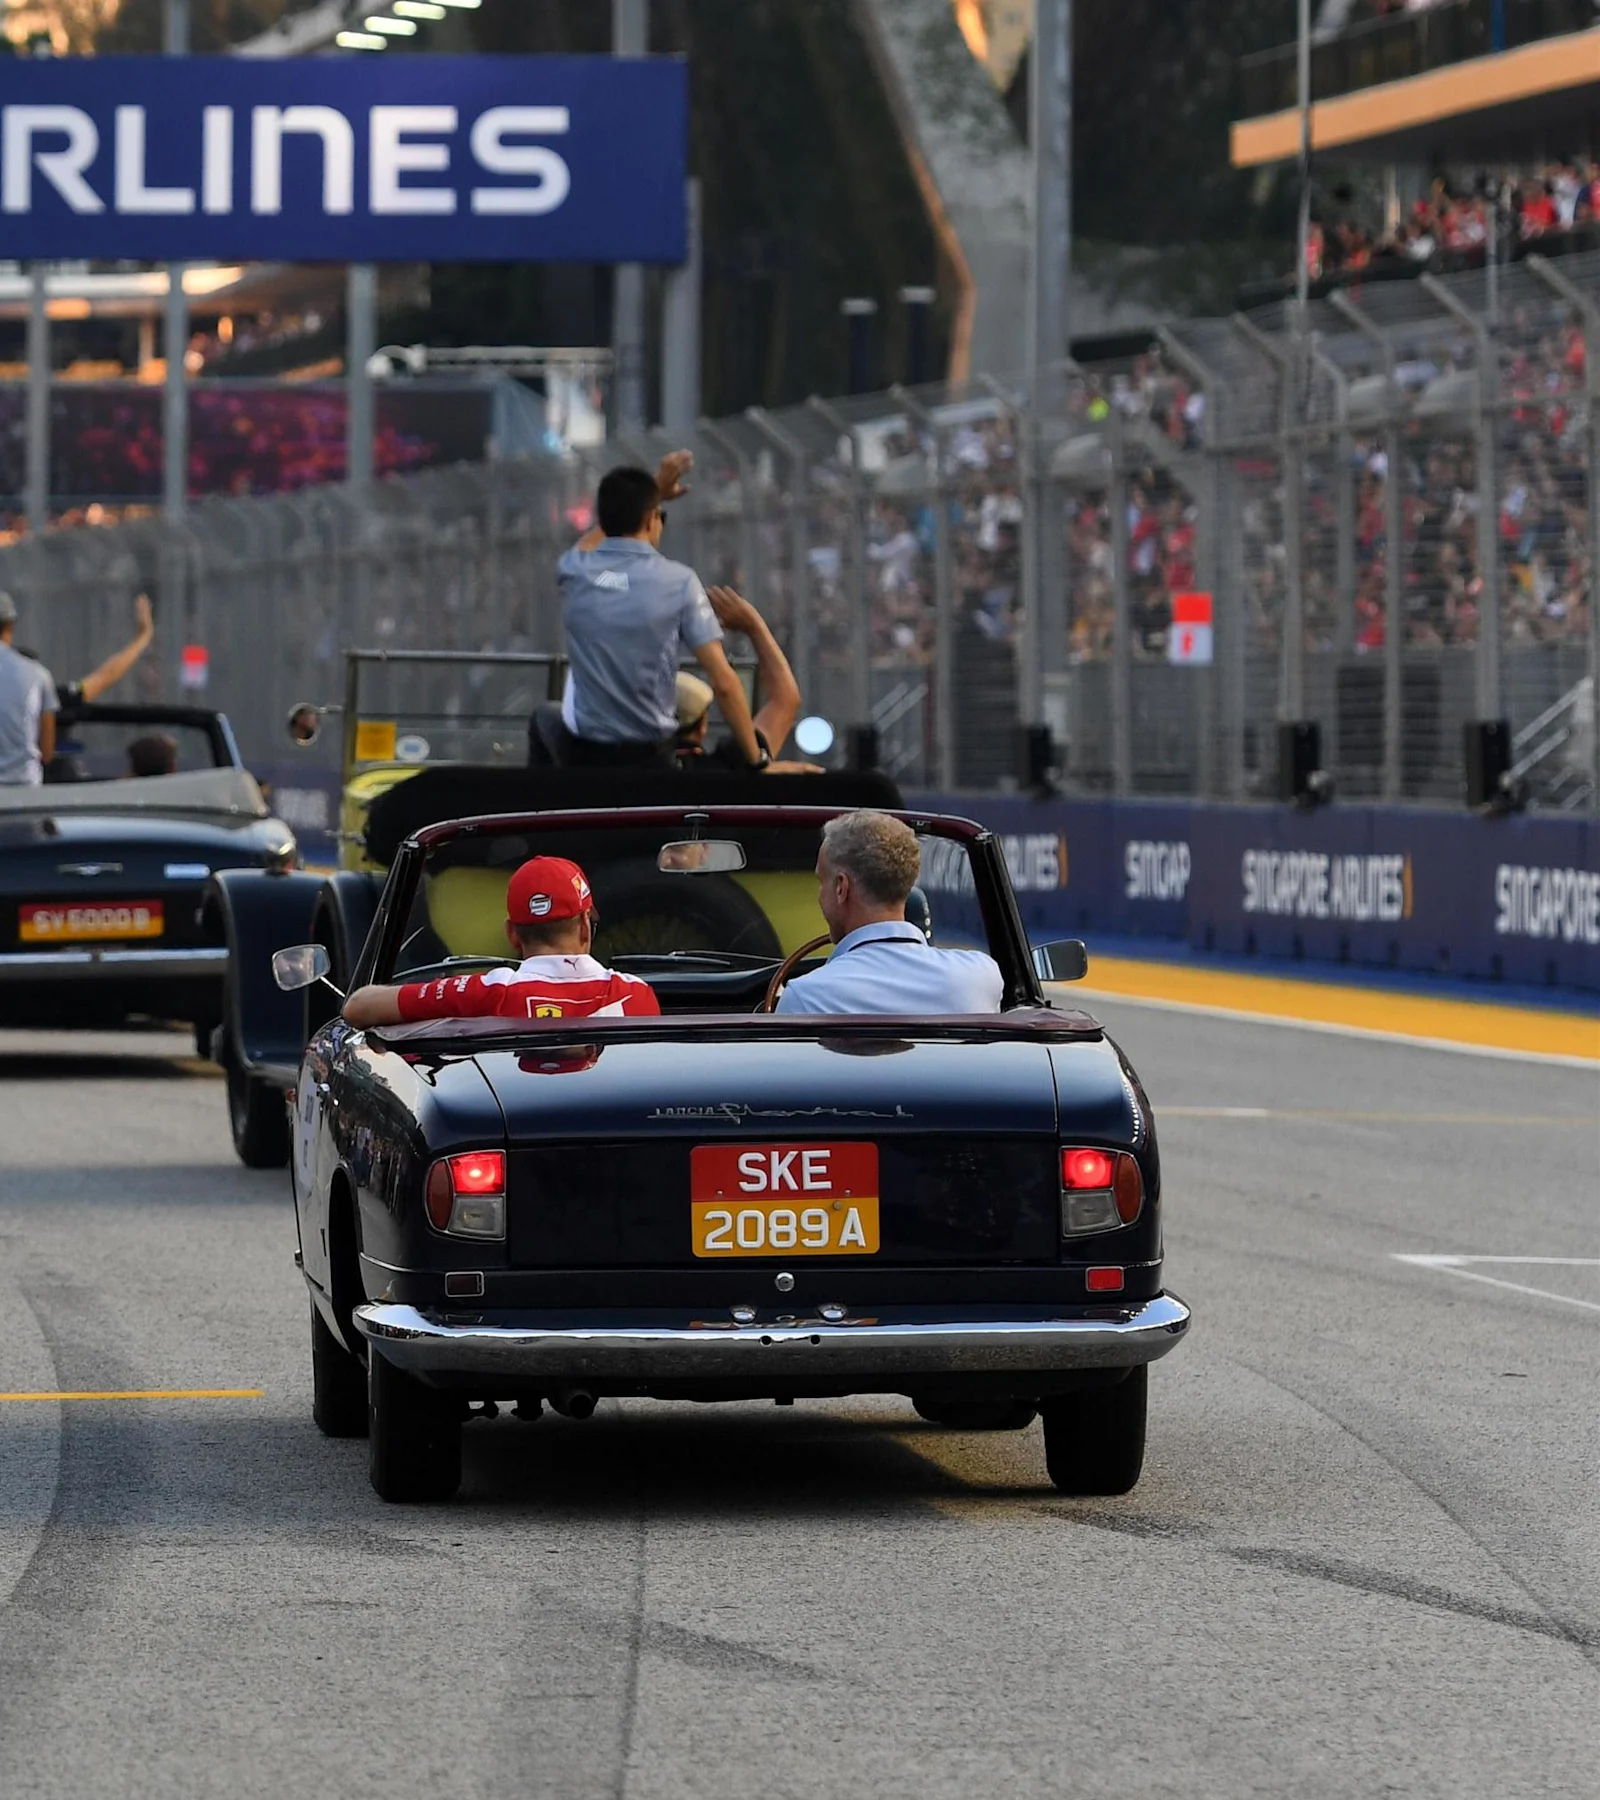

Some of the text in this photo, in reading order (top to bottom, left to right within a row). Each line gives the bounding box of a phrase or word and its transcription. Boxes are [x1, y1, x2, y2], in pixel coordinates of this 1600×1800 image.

[1242, 848, 1404, 921] SINGAPORE AIRLINES
[737, 1150, 832, 1192] SKE
